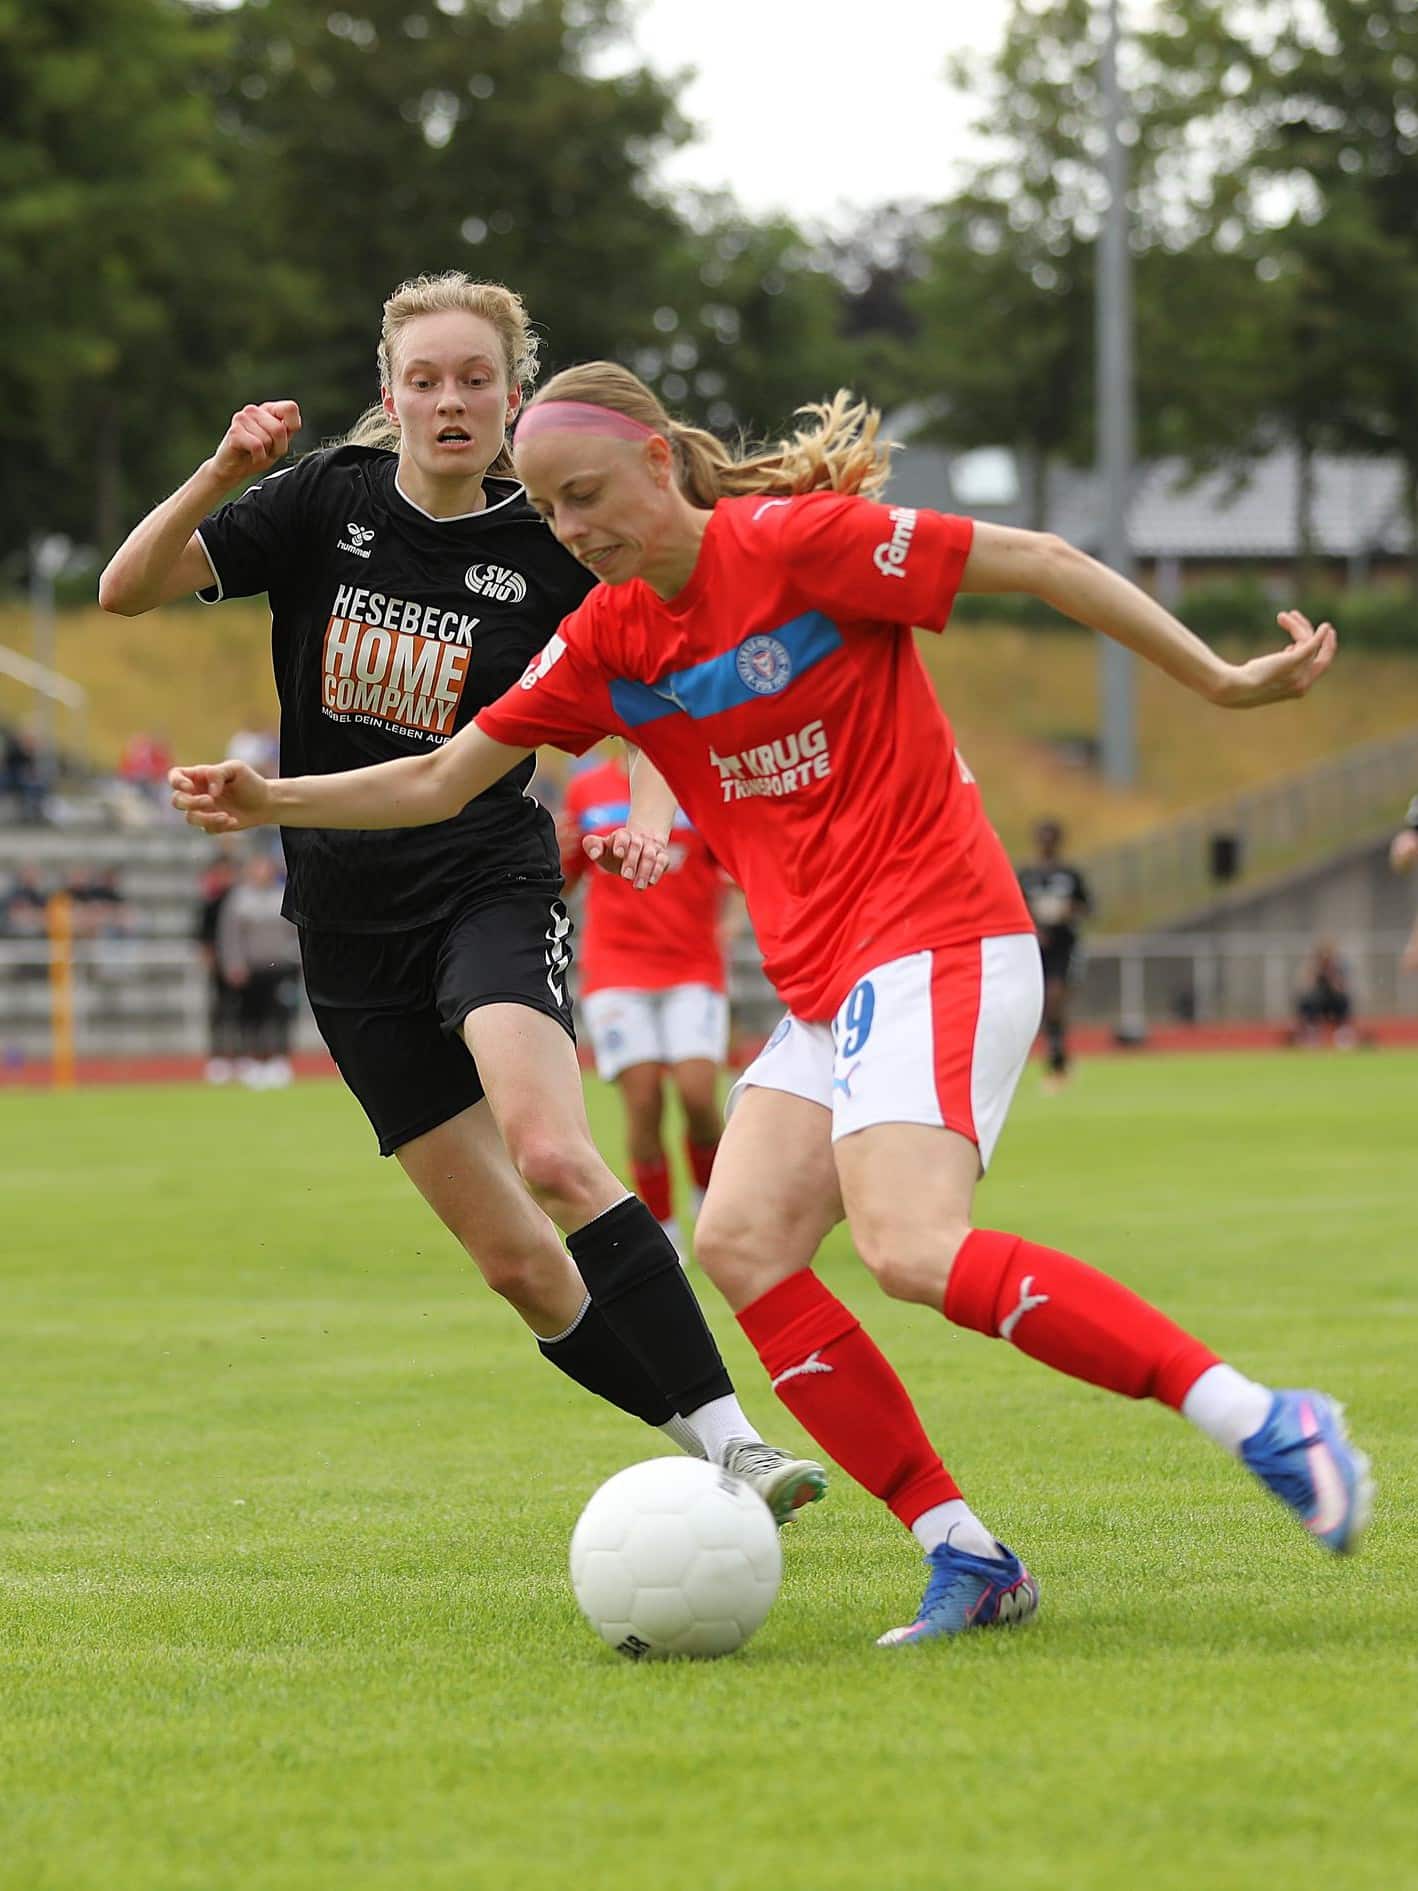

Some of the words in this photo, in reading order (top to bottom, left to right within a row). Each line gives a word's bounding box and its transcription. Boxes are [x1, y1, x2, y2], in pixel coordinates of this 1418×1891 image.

[337, 539, 371, 559] hummel
[482, 565, 512, 584] SV
[332, 584, 480, 648] HESEBECK
[482, 581, 511, 601] HU
[324, 619, 469, 703] HOME
[323, 674, 456, 731] COMPANY
[354, 714, 383, 728] DEIN
[385, 722, 424, 740] LEBEN
[741, 720, 828, 777] KRUG
[834, 980, 875, 1058] 9
